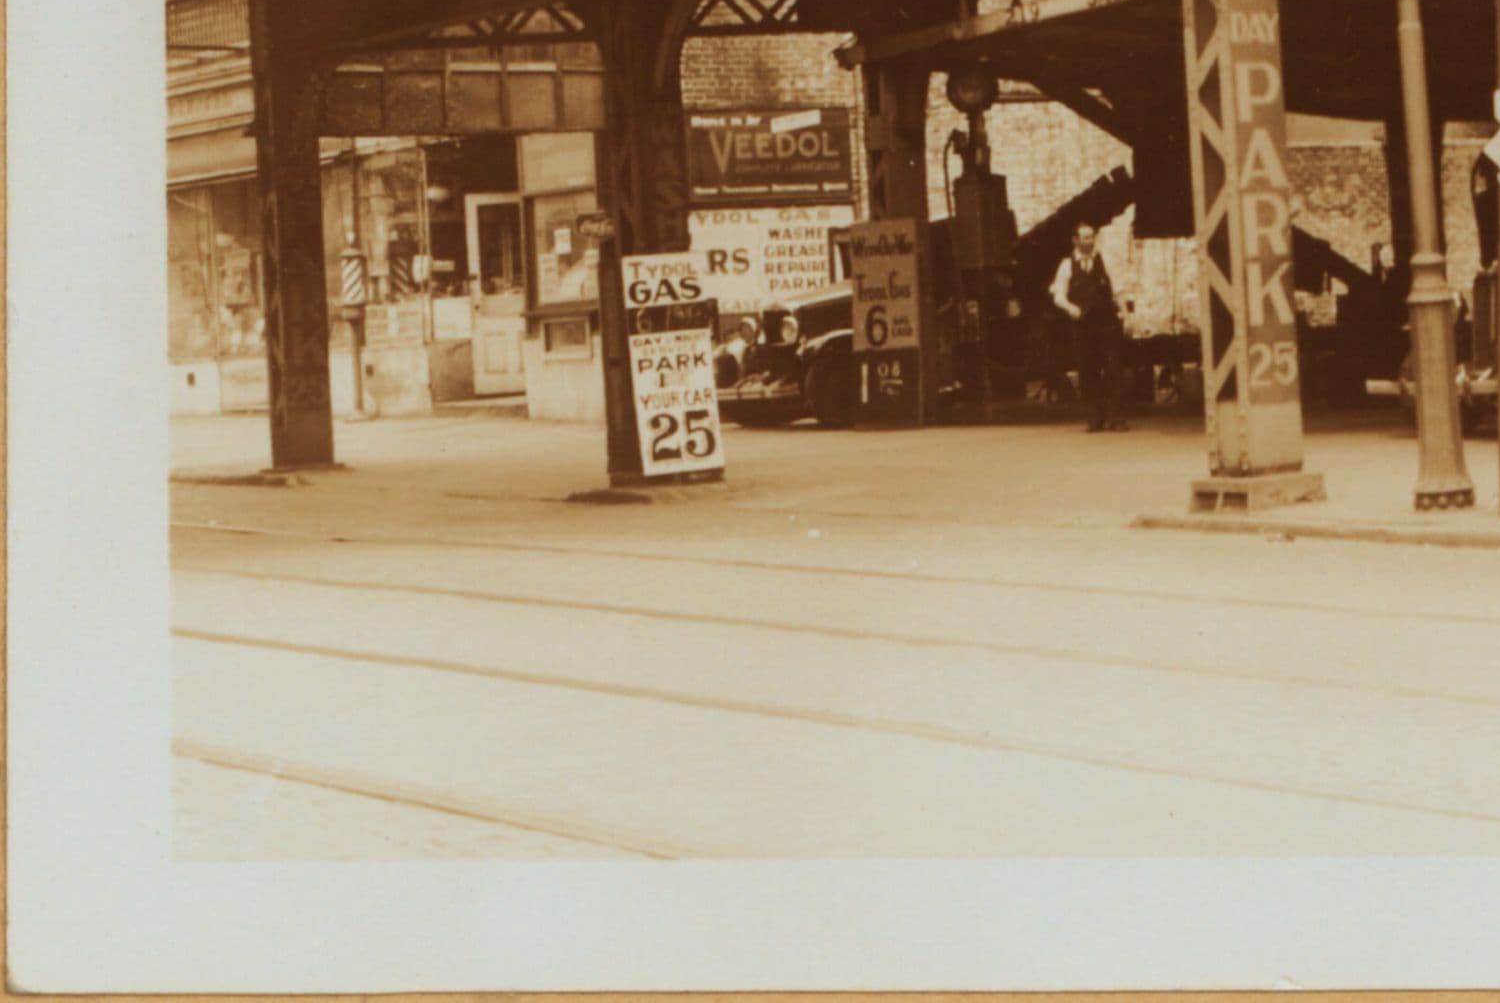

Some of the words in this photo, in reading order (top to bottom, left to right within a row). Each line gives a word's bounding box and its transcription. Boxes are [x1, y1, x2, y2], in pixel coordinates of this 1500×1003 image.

[1230, 11, 1279, 45] DAY
[709, 129, 840, 175] VEEDOL
[1235, 62, 1295, 326] PARK
[696, 211, 760, 227] YDOL
[768, 227, 823, 241] WASHE
[706, 246, 751, 277] RS
[763, 243, 825, 259] GREASE
[764, 260, 827, 276] REPAIRE
[629, 277, 702, 306] GAS
[769, 277, 828, 293] PARKE
[865, 305, 888, 346] 6
[637, 351, 708, 375] PARK
[1248, 341, 1299, 387] 25
[639, 391, 682, 411] YOUR
[684, 387, 713, 406] CAR
[647, 408, 717, 464] 25
